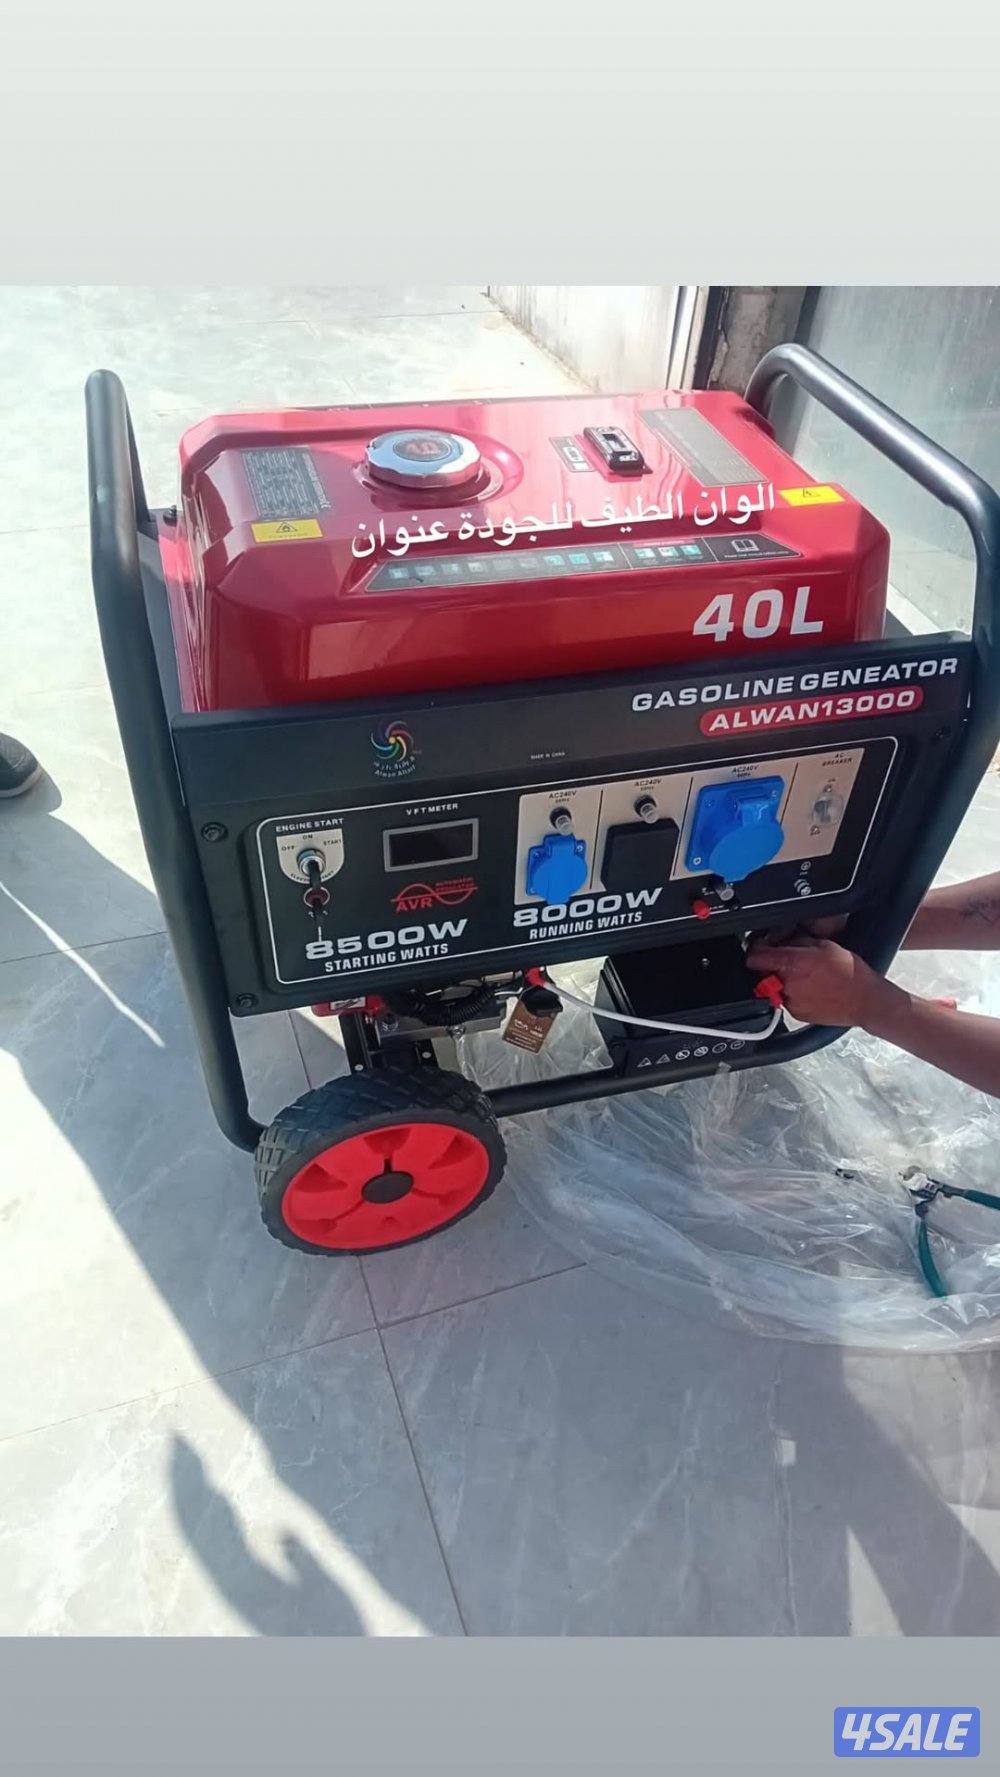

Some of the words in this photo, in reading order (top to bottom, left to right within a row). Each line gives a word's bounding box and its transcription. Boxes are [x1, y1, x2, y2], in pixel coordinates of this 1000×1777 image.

[693, 586, 824, 642] 40L
[631, 675, 795, 711] GASOLINE
[800, 657, 958, 691] GENEATOR
[708, 690, 915, 732] ALWAN13000
[731, 764, 759, 773] AC240V
[275, 822, 313, 832] ENGINE
[314, 818, 344, 828] START
[396, 897, 434, 913] AVR
[513, 887, 663, 928] 8000W
[306, 919, 468, 960] 8500W
[529, 919, 593, 941] RUNNING
[597, 911, 643, 930] WATTS
[325, 953, 397, 973] STARTING
[400, 943, 449, 963] WATTS
